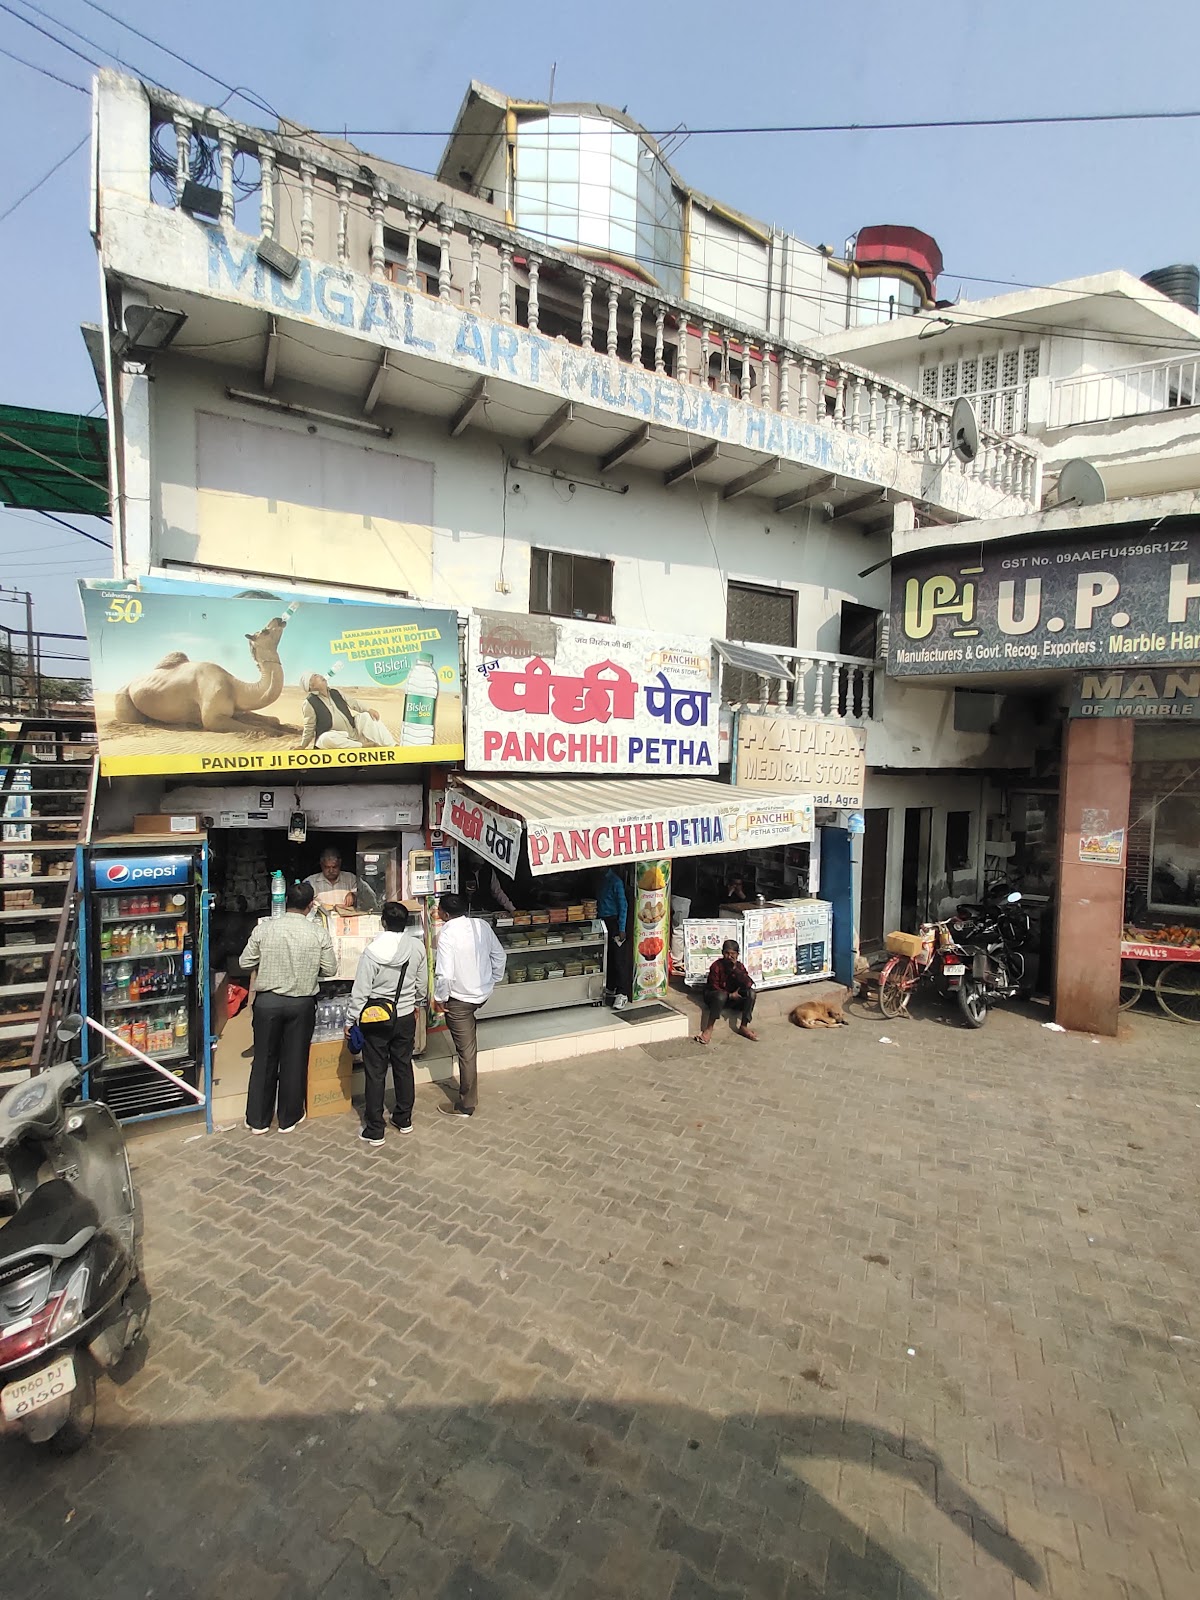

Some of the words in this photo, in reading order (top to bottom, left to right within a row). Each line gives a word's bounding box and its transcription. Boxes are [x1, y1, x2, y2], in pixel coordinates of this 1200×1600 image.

[207, 229, 436, 352] MUGAL
[453, 312, 551, 384] ART
[560, 349, 729, 438] MUSEUM
[1001, 558, 1028, 569] GST
[1031, 556, 1052, 567] No.
[1056, 540, 1189, 564] 09AAEFU4596R1Z2
[107, 598, 143, 623] 50
[997, 571, 1130, 636] U.P.
[333, 640, 356, 652] HAR
[358, 636, 390, 648] PAANI
[391, 634, 403, 644] KI
[404, 630, 437, 642] BOTTLE
[896, 648, 963, 664] Manufacturers
[965, 645, 973, 659] &
[975, 644, 1002, 659] Govt.
[1004, 642, 1040, 660] Recog.
[1043, 638, 1096, 657] Exporters
[1108, 632, 1166, 654] Marble
[351, 647, 385, 660] BISLERI
[387, 643, 420, 655] NAHIN
[662, 653, 700, 666] PANCHHI
[663, 666, 681, 674] PETHA
[680, 668, 698, 676] STORE
[1080, 674, 1200, 699] MAN
[406, 702, 432, 713] Bisleri
[643, 671, 712, 727] पेठा
[1081, 704, 1104, 716] OF
[1114, 703, 1195, 716] MARBLE
[483, 730, 618, 764] PANCHHI
[628, 736, 713, 767] PETHA
[201, 755, 265, 770] PANDIT
[269, 755, 286, 768] JI
[287, 753, 333, 766] FOOD
[337, 750, 396, 764] CORNER
[744, 757, 812, 783] MEDICAL
[815, 763, 860, 786] STORE
[835, 795, 859, 807] Agra
[749, 812, 793, 825] PANCHHI
[485, 816, 515, 865] पेठा
[528, 820, 666, 867] PANCHHI
[667, 815, 725, 849] PETHA
[534, 826, 549, 838] Brij
[751, 828, 771, 836] PETHA
[771, 826, 790, 834] STORE
[131, 864, 178, 882] pepsi
[1134, 947, 1168, 958] WALL'S
[0, 1262, 35, 1280] HONDA
